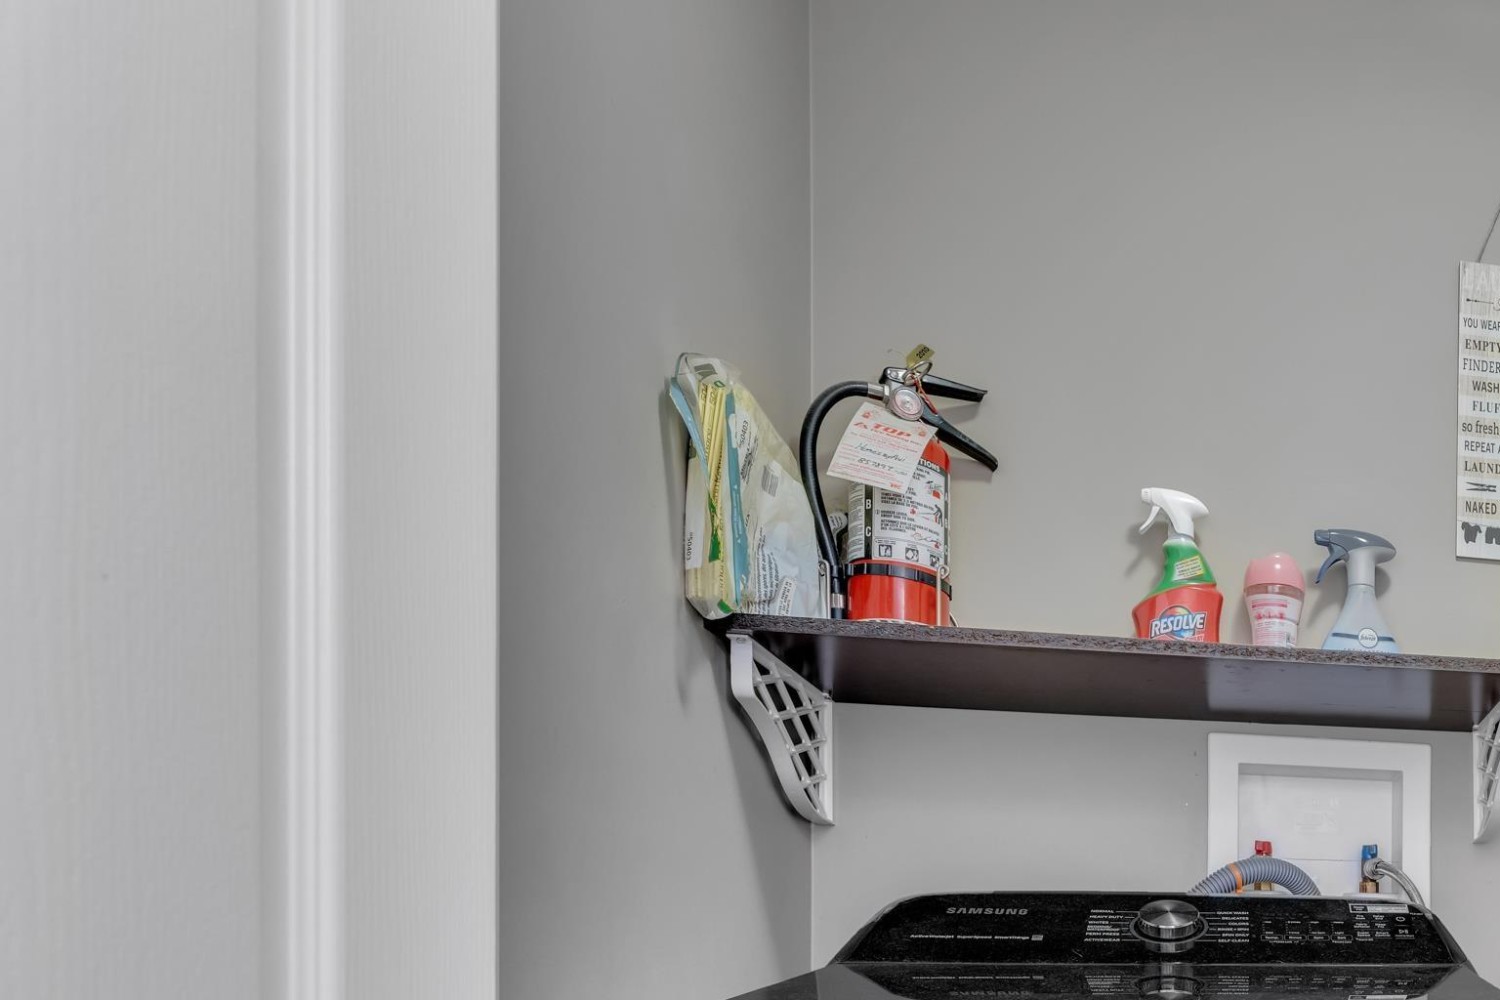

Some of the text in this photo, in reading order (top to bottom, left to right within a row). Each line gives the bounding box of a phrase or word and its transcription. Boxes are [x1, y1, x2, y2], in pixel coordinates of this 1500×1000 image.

[1463, 317, 1478, 329] YOU
[1472, 380, 1500, 394] WASH
[1461, 422, 1473, 433] so
[1475, 420, 1499, 436] fresh
[1464, 440, 1496, 454] REPEAT
[1465, 501, 1497, 516] NAKED
[1151, 613, 1205, 638] RESOLVE
[946, 907, 1029, 915] SAMSUNG
